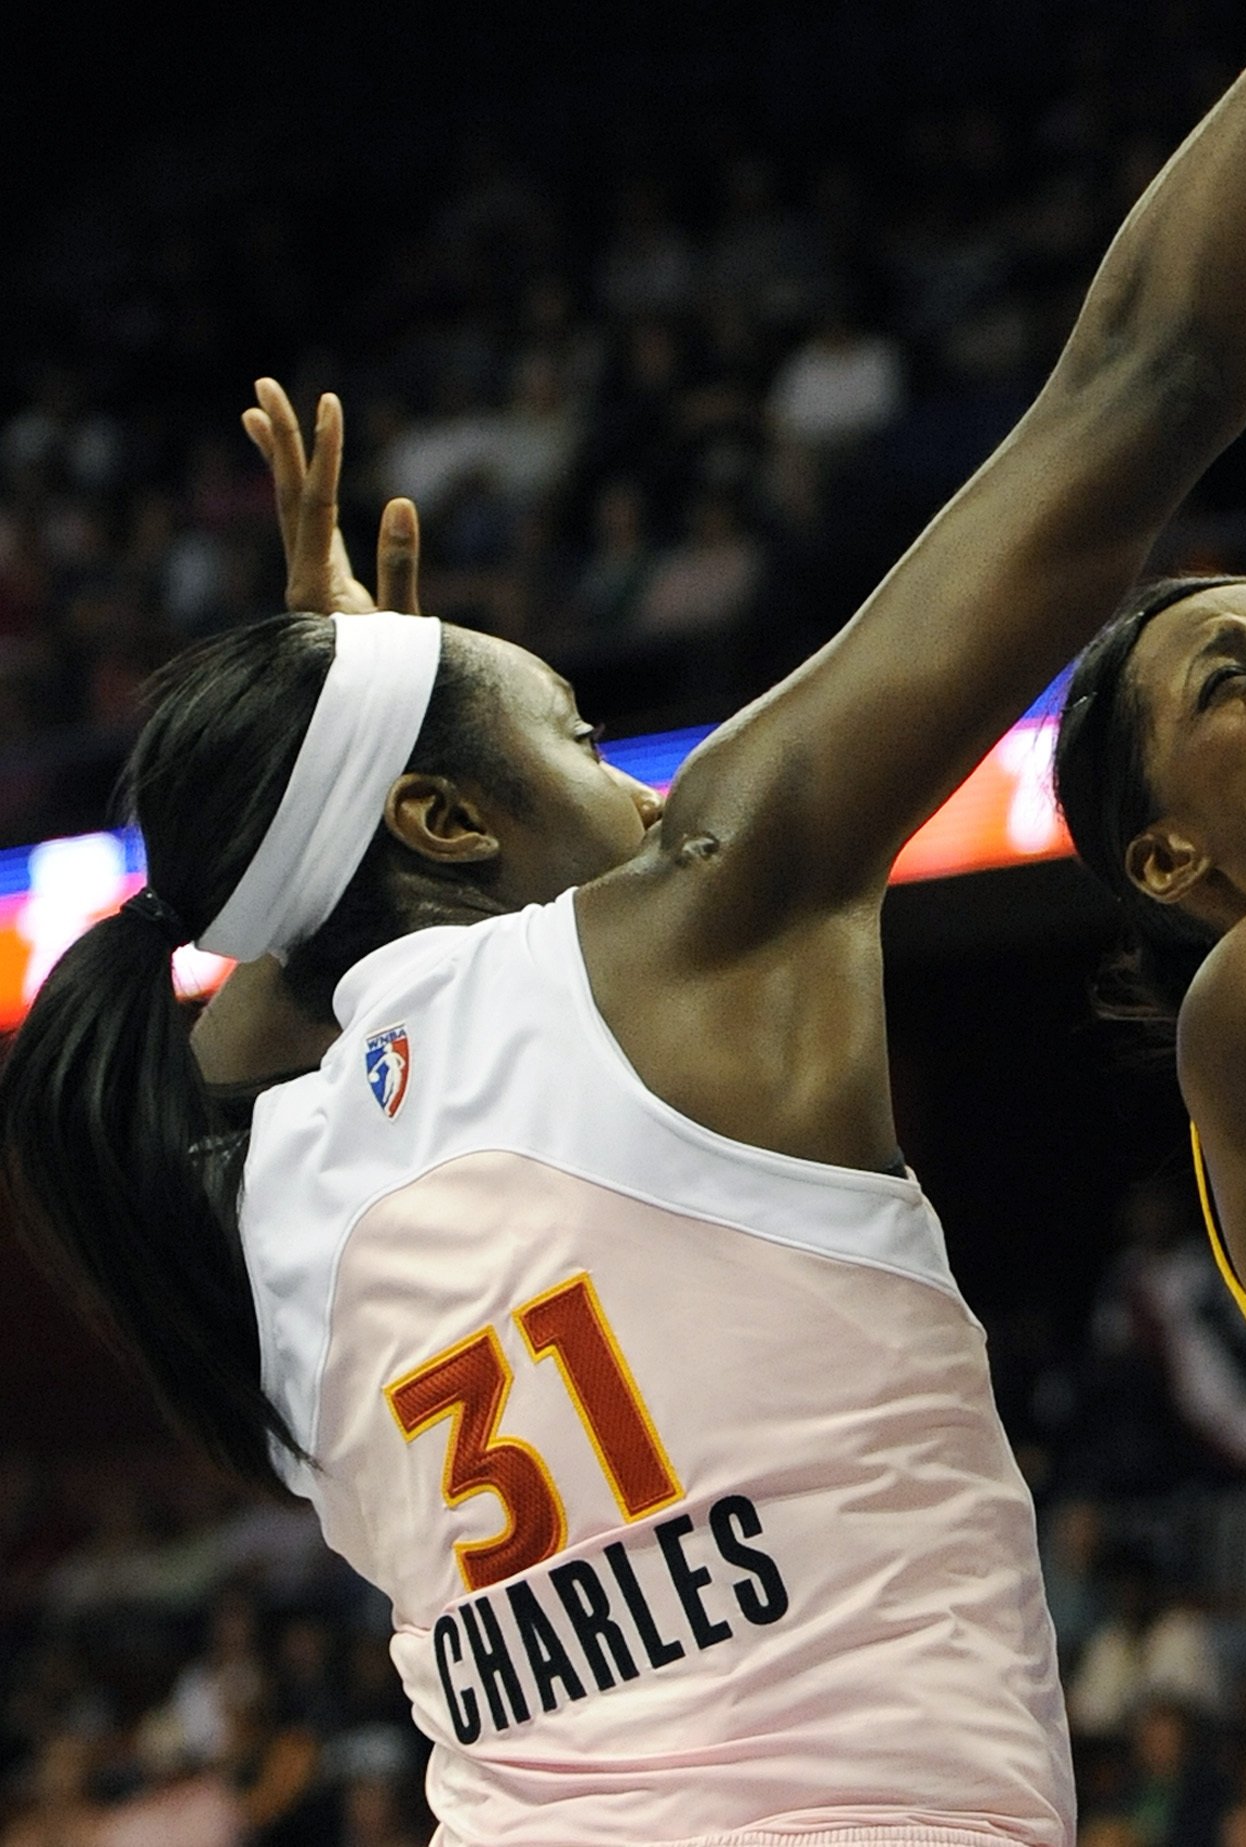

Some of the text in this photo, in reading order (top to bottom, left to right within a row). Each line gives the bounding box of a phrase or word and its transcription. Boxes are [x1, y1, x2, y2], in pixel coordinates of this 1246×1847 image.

[367, 1028, 408, 1050] WNBA
[383, 1271, 687, 1593] 31
[433, 1494, 789, 1746] CHARLES
